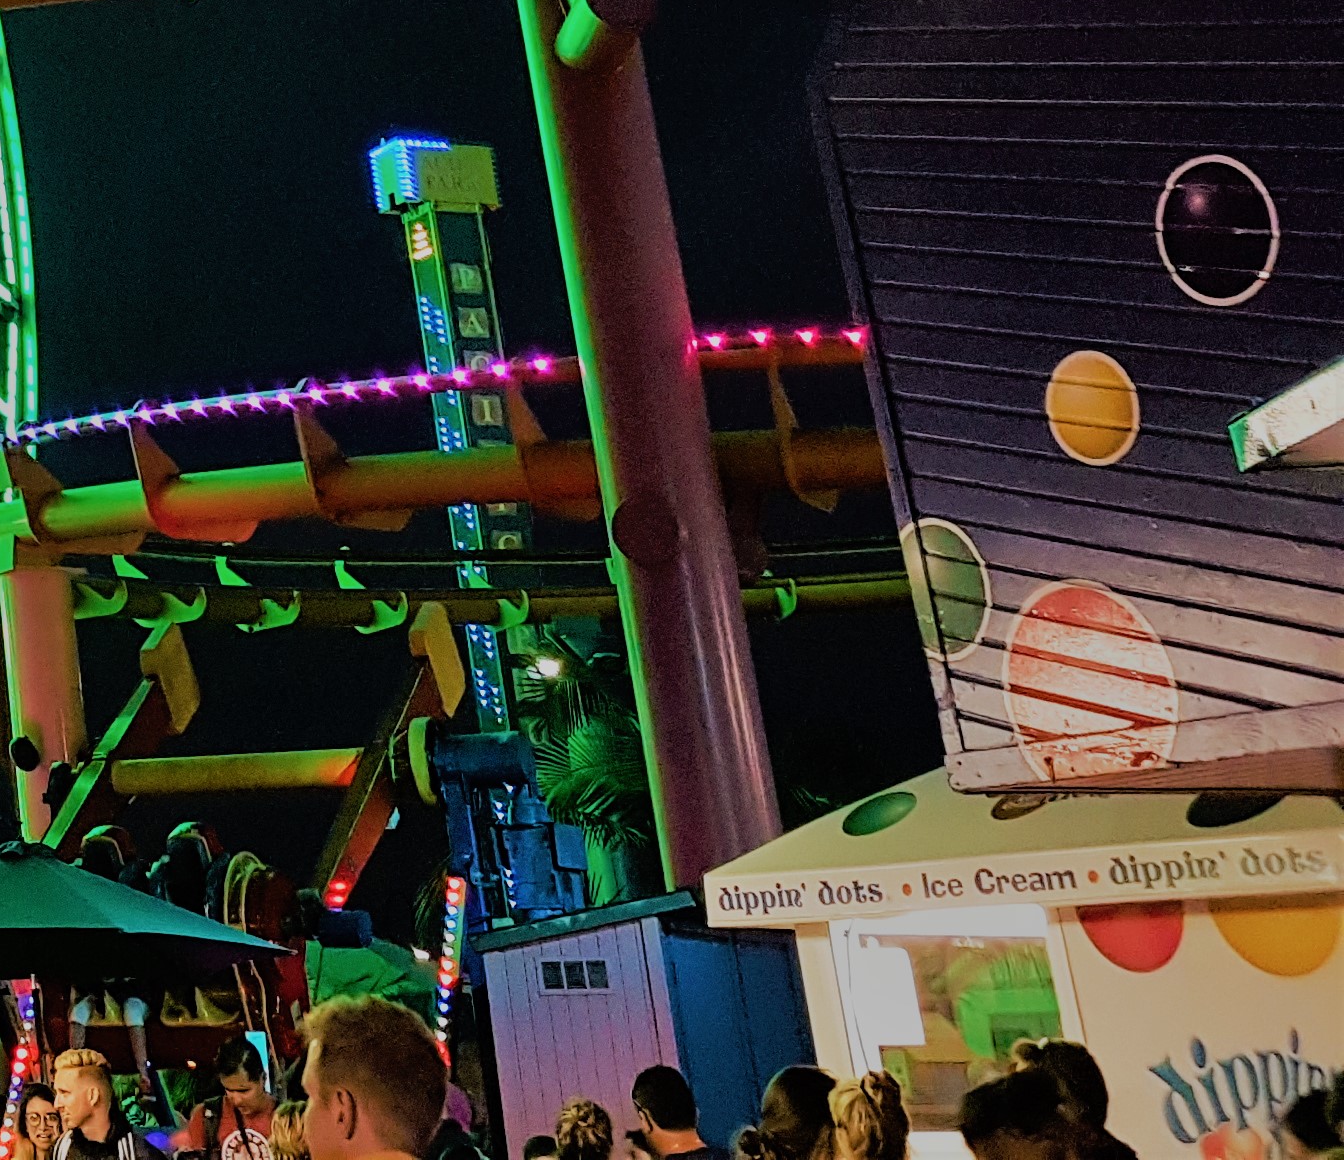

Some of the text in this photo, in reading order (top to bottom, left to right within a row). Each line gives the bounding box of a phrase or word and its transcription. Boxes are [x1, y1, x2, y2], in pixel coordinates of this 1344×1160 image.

[718, 847, 1327, 916] dippin' dots Ice Cream dippin' dots
